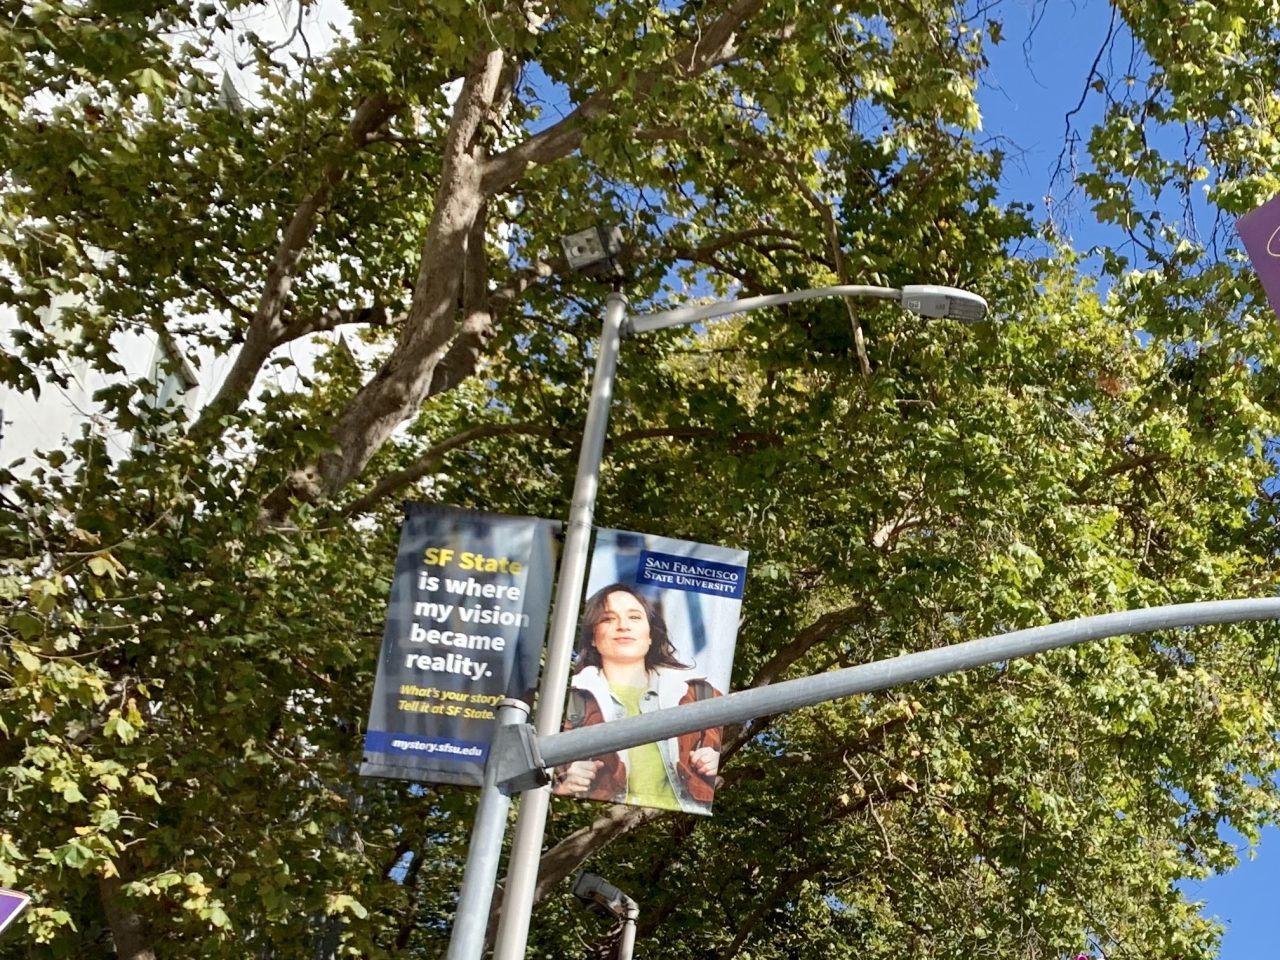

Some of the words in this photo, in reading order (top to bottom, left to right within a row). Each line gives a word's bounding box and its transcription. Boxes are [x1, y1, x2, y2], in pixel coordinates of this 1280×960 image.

[422, 547, 454, 566] SF
[456, 552, 523, 576] State
[645, 556, 670, 571] SAN
[672, 561, 739, 582] FRANCISCO
[417, 572, 440, 592] is
[444, 576, 521, 602] where
[643, 570, 674, 583] STATE
[675, 574, 737, 594] UNIVERSITY
[413, 601, 453, 622] my
[457, 604, 530, 628] vision
[410, 622, 506, 652] became
[404, 651, 493, 681] reality.
[400, 683, 440, 699] What's
[439, 690, 470, 705] your
[398, 700, 420, 713] Tell
[420, 702, 431, 714] it
[431, 704, 444, 716] at
[443, 704, 462, 717] SF
[463, 706, 497, 720] State.
[390, 738, 483, 758] mystory.sfsu.edu
